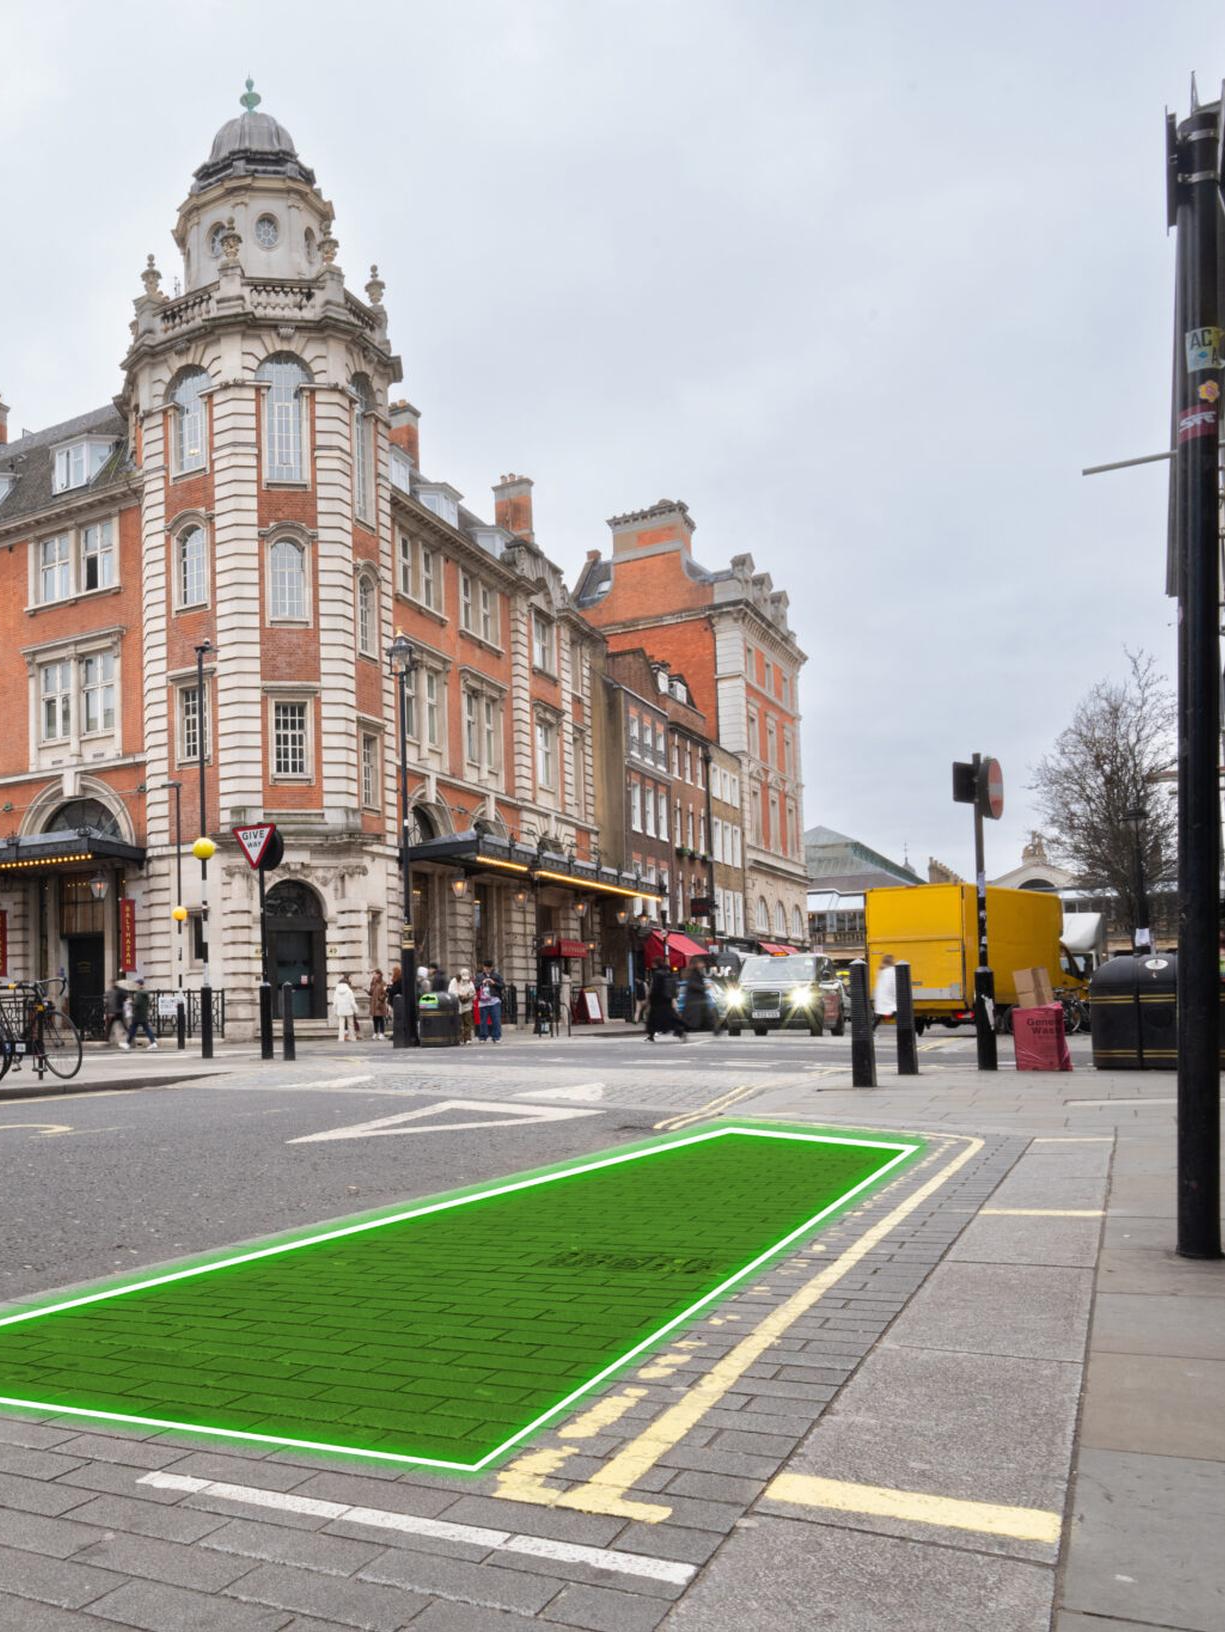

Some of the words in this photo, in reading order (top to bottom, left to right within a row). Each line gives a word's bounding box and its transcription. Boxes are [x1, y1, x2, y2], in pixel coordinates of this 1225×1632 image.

[241, 829, 265, 841] GIVE
[247, 841, 262, 849] WAY
[124, 903, 133, 966] BALTHAZAR
